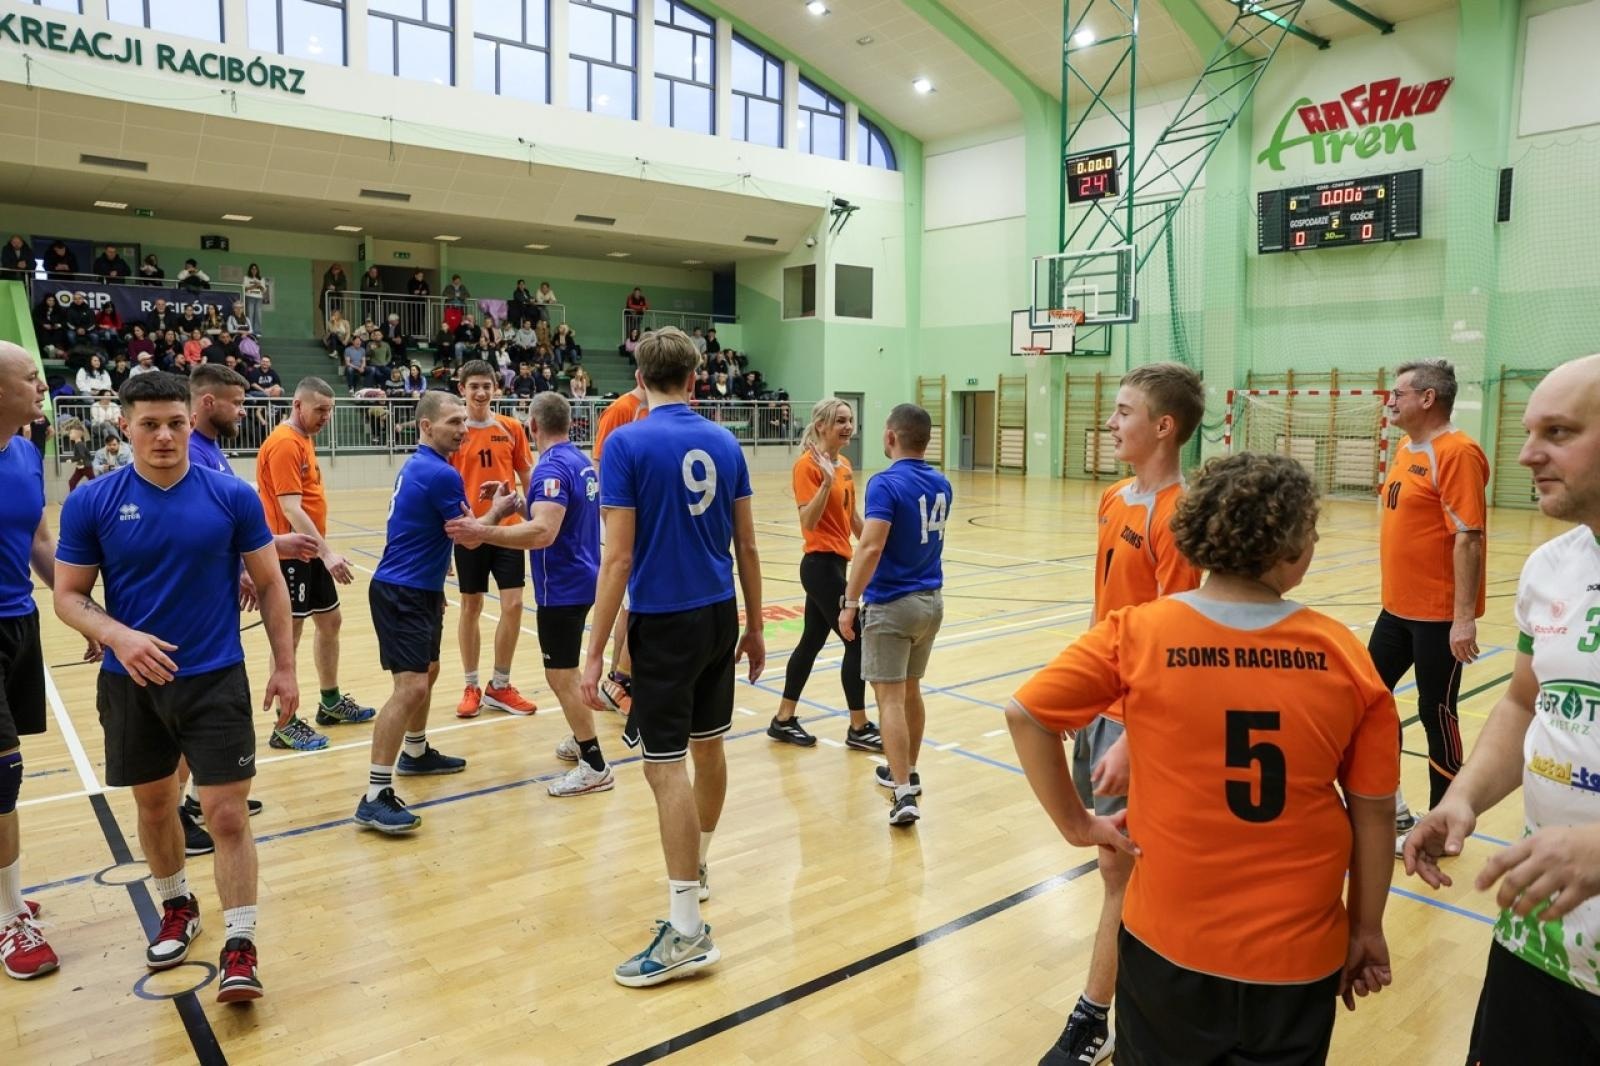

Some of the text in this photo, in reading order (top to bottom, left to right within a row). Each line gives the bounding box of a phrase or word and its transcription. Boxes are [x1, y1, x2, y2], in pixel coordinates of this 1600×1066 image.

[157, 43, 306, 95] RACIBÓRZ
[1298, 77, 1455, 134] RAFAKO
[1080, 173, 1107, 197] 24
[1290, 215, 1330, 228] GOSPODARZE
[1331, 219, 1340, 229] 2
[1362, 223, 1373, 239] 0
[1295, 231, 1306, 246] 0
[478, 448, 492, 468] 11
[682, 448, 718, 517] 9
[1387, 480, 1402, 510] 10
[918, 492, 948, 545] 14
[1120, 525, 1144, 549] ZSOMS
[298, 582, 306, 602] 8
[1166, 646, 1328, 671] ZSOMS RACIBÓRZ
[1225, 710, 1286, 824] 5
